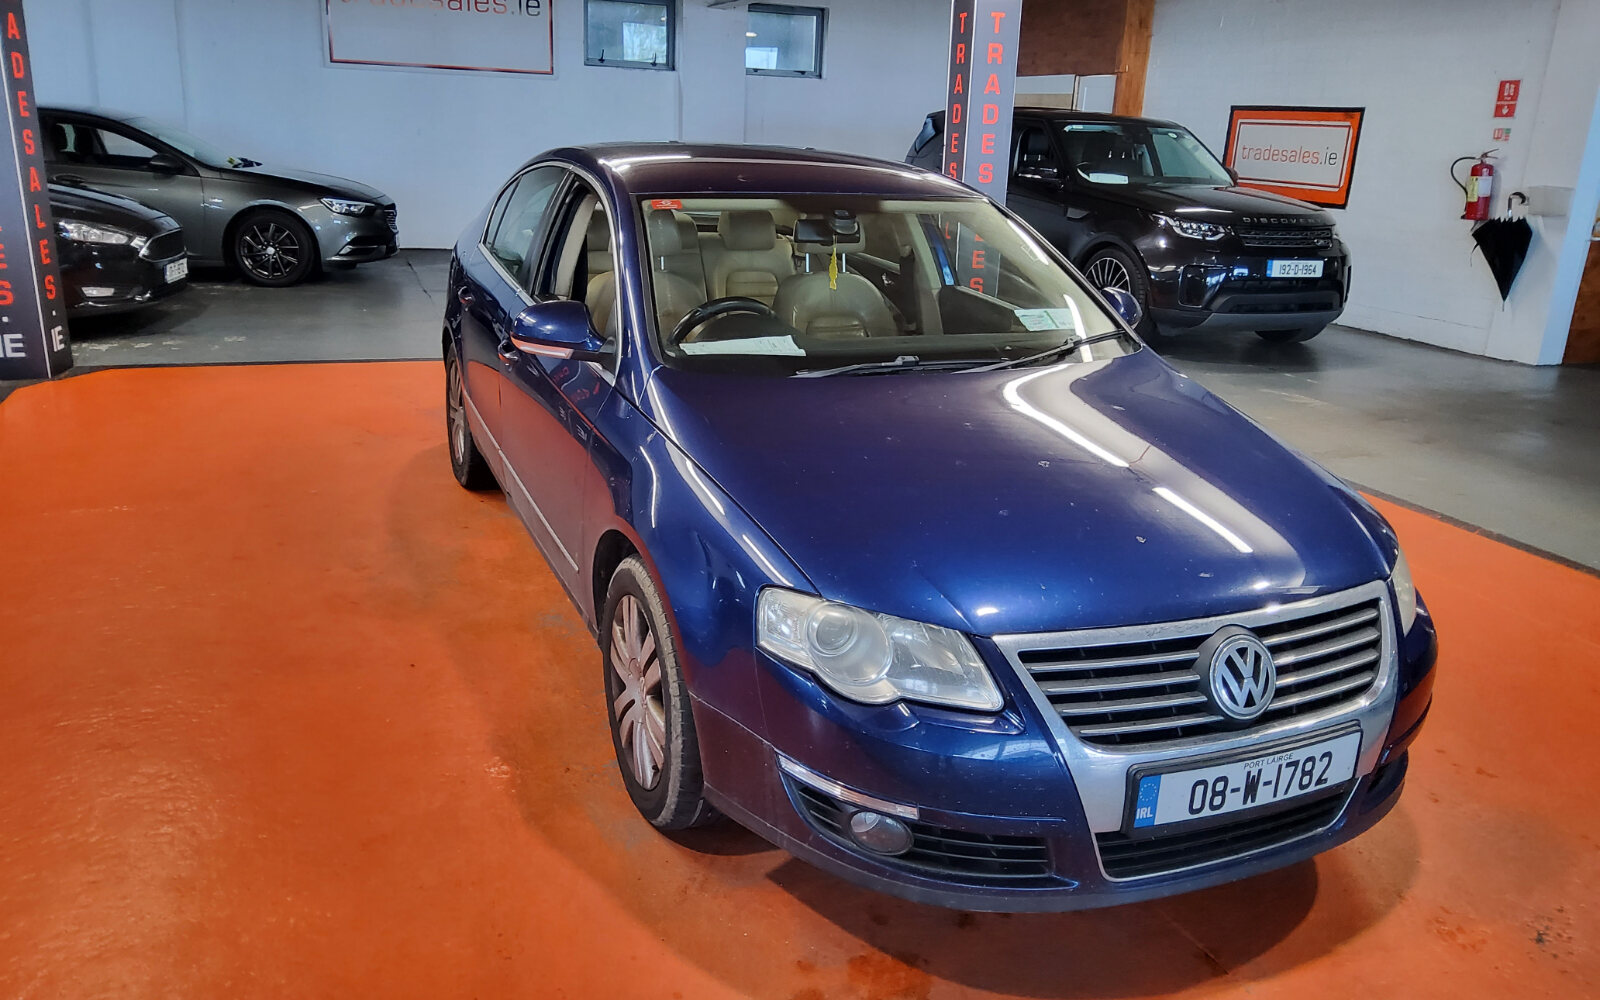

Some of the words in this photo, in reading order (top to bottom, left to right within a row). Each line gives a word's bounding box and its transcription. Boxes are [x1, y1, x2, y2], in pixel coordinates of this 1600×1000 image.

[1241, 145, 1338, 166] tradesales.ie
[1244, 760, 1264, 770] PORT
[1188, 751, 1333, 815] 08-W-1782
[1136, 807, 1153, 820] IRL
